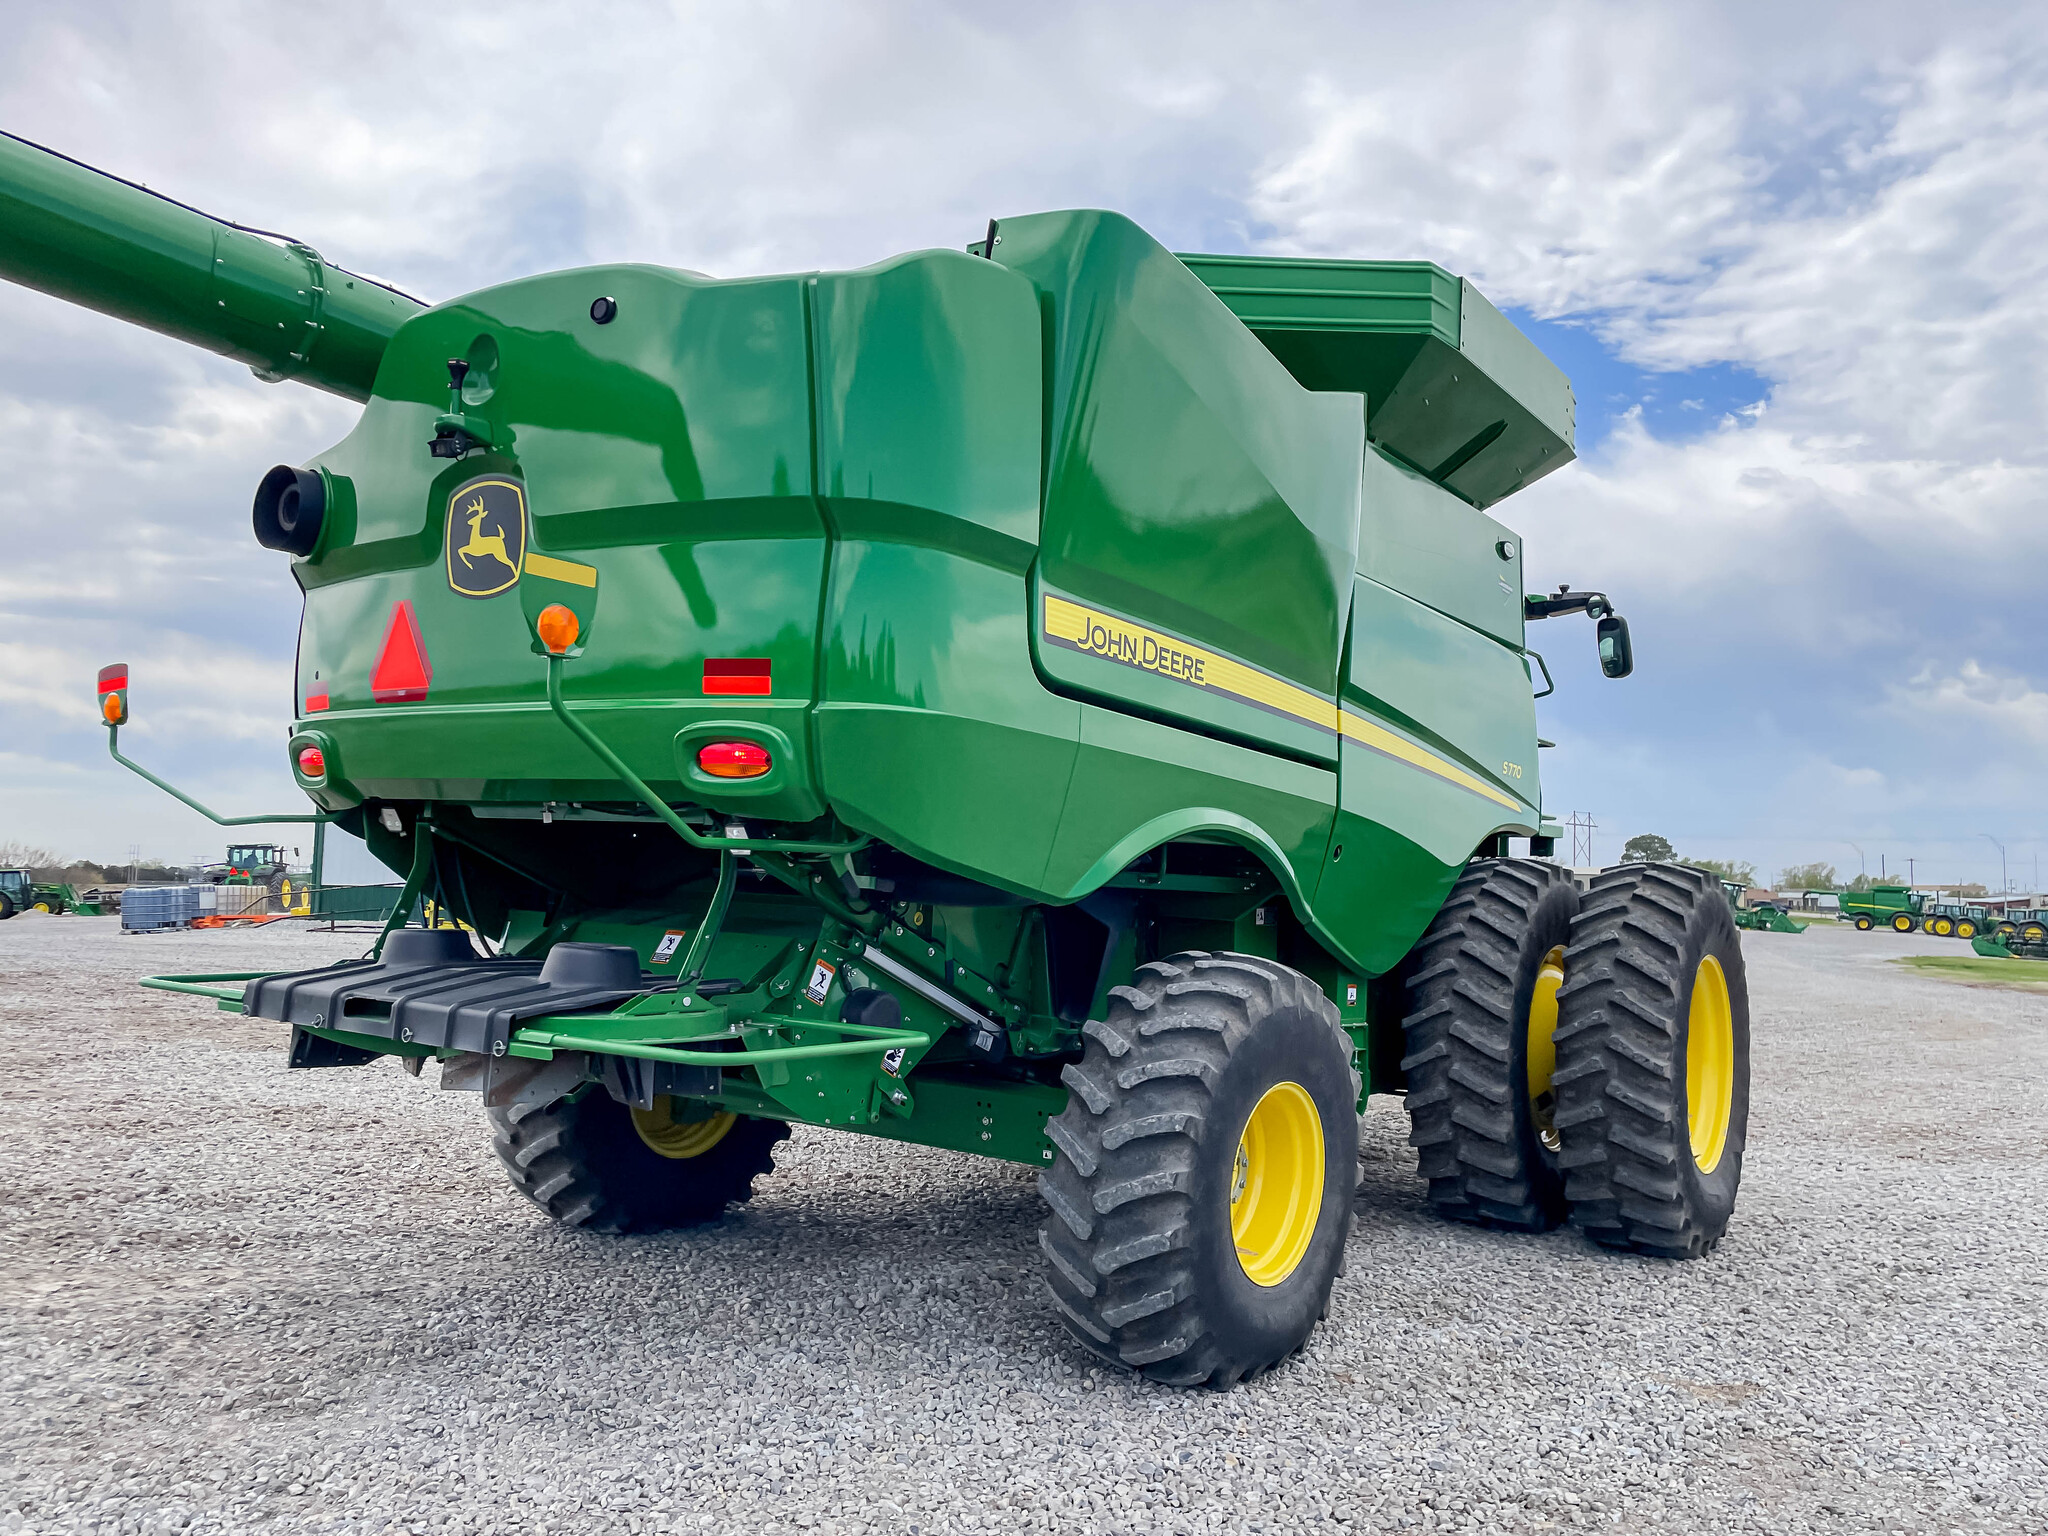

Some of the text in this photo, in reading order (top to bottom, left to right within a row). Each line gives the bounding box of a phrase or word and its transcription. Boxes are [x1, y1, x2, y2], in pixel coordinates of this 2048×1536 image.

[1077, 616, 1206, 682] JOHN DEERE
[1502, 760, 1522, 779] S770
